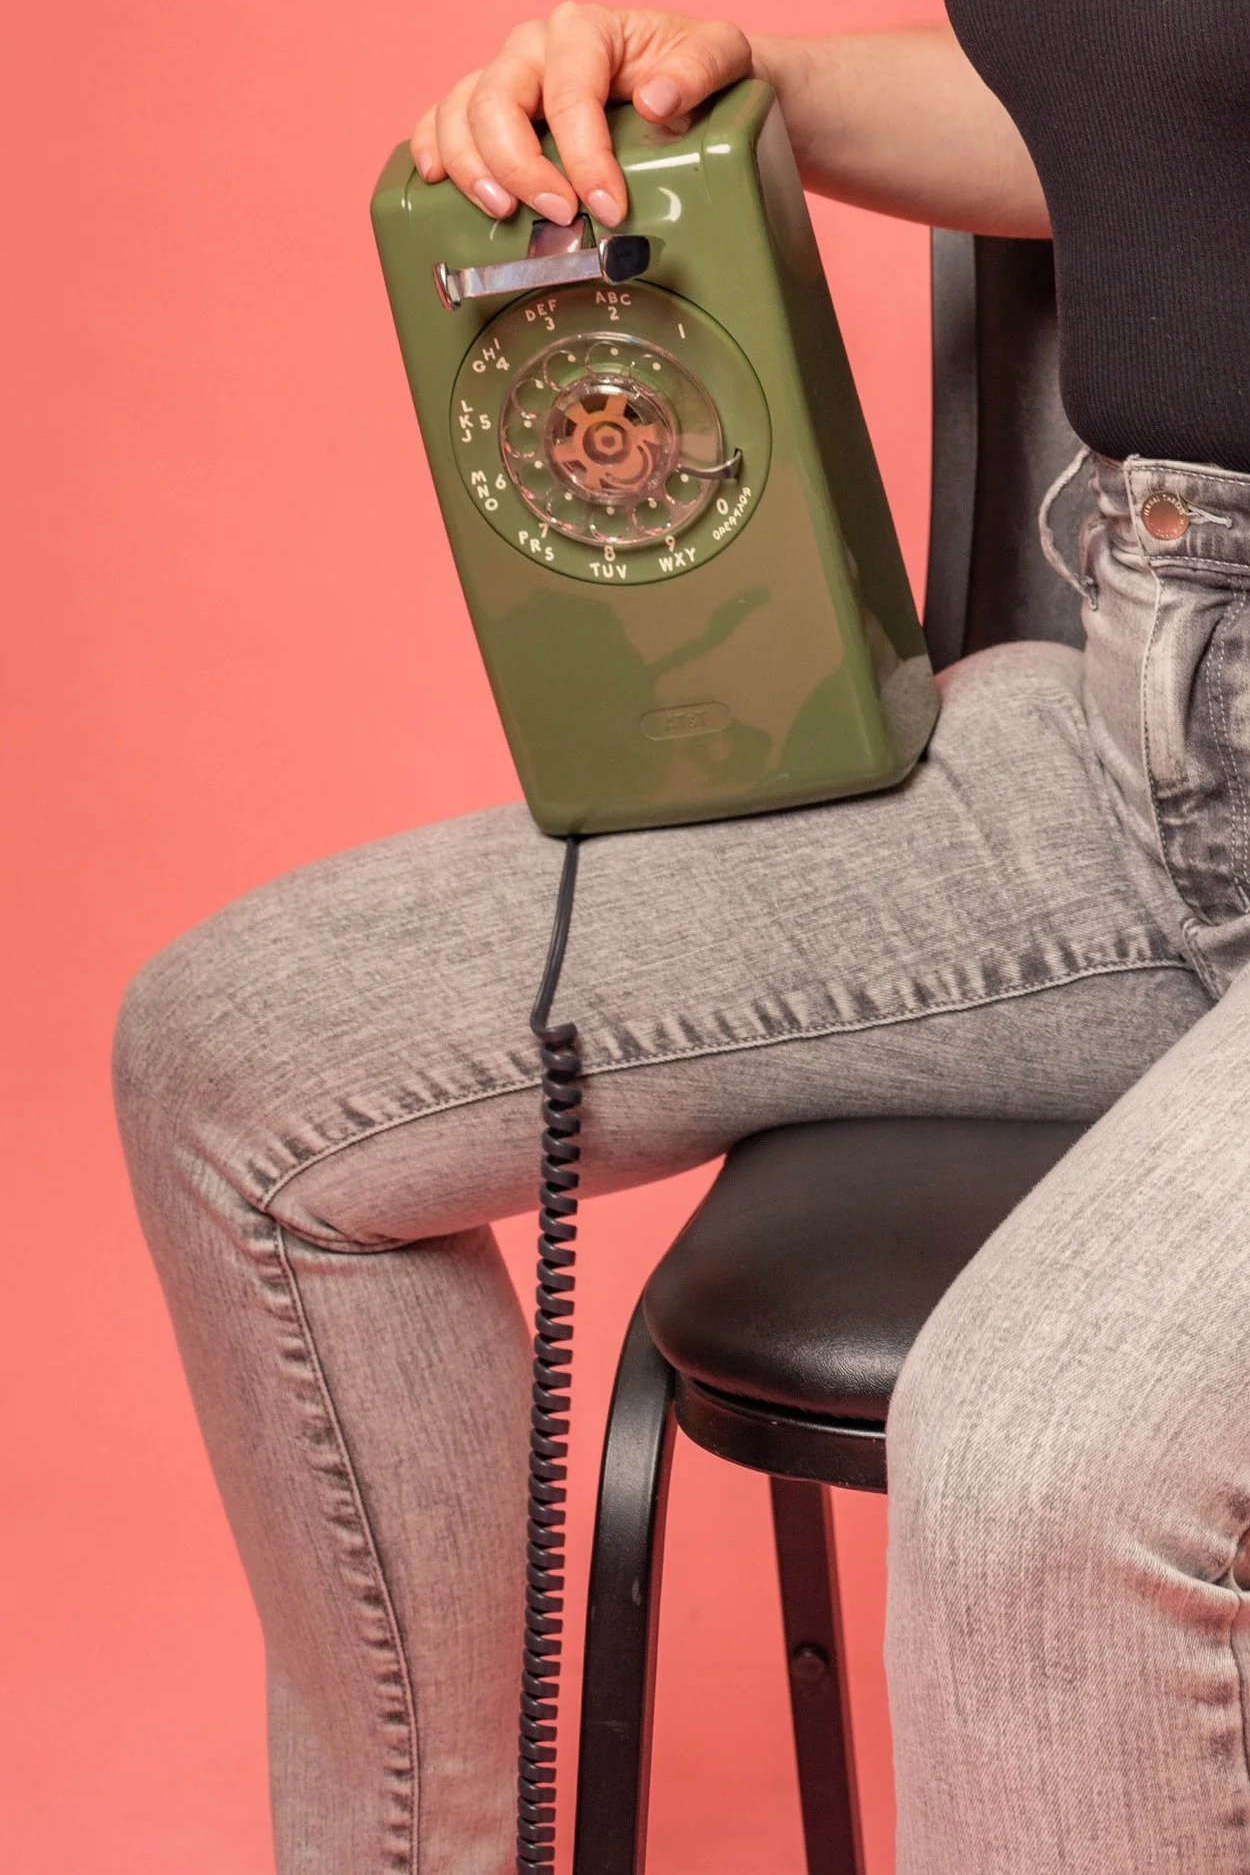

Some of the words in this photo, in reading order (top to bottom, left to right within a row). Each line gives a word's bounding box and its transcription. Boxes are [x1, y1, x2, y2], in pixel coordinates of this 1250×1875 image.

[595, 291, 632, 305] ABC
[525, 299, 557, 322] DEF
[607, 306, 619, 321] 2
[544, 316, 556, 331] 3
[472, 338, 500, 373] GHI
[495, 356, 510, 371] 4
[478, 414, 492, 430] 5
[494, 473, 507, 490] 6
[471, 470, 499, 511] MNO
[712, 486, 752, 541] OPERATOR
[538, 523, 549, 539] 7
[518, 530, 554, 561] PRS
[664, 535, 676, 552] 9
[603, 545, 616, 562] 8
[658, 547, 696, 573] WXY
[589, 561, 627, 579] TUV
